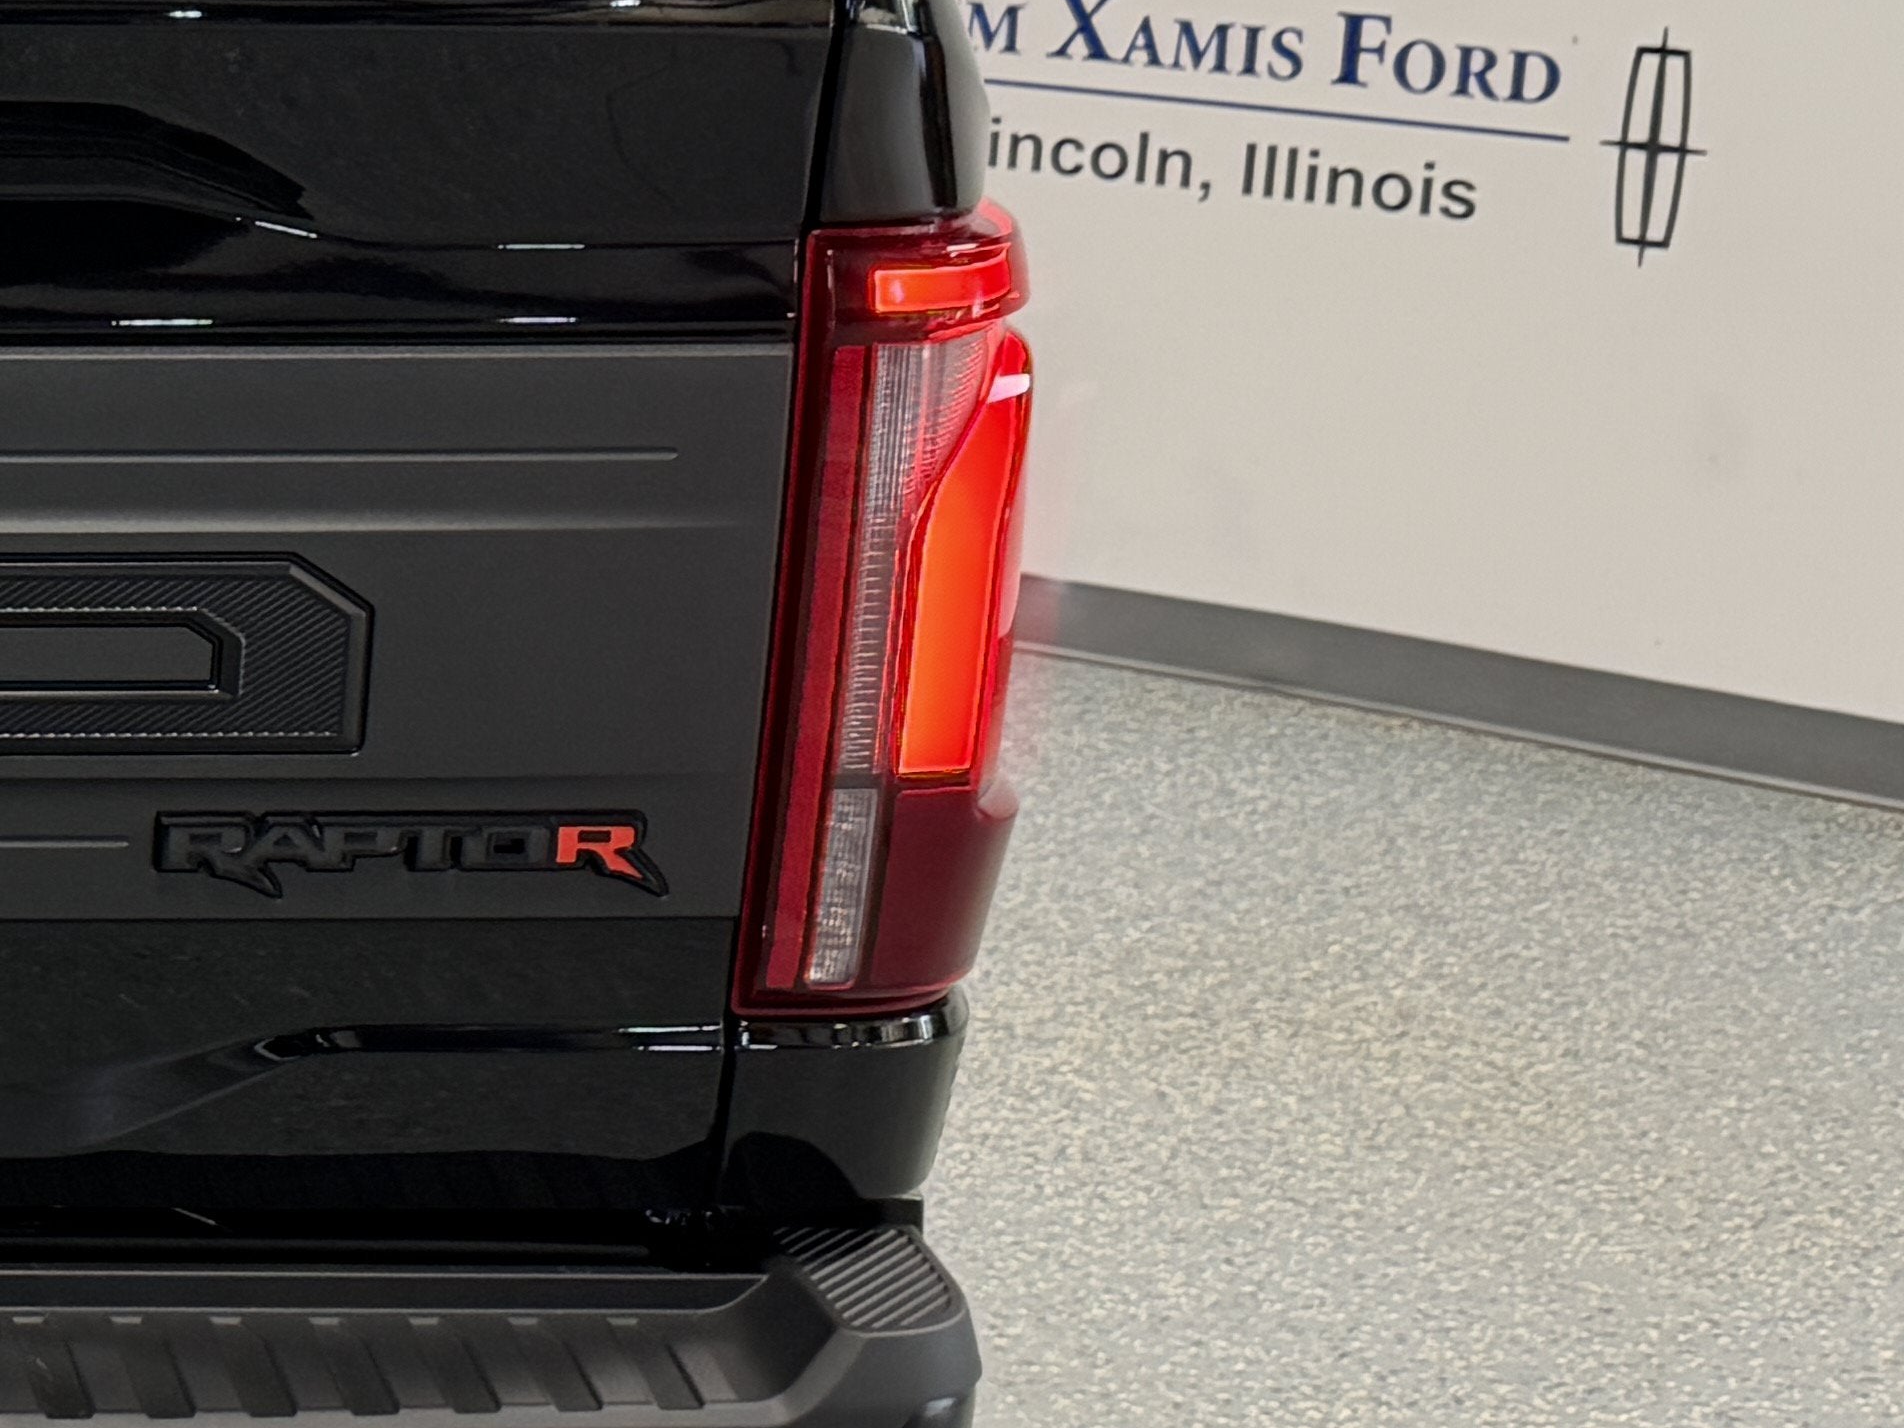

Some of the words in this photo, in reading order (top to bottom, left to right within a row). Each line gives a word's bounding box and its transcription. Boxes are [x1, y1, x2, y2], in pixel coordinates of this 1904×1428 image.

[1330, 11, 1561, 104] FORD
[987, 116, 1211, 202] incoln,
[1241, 142, 1477, 220] Illinois
